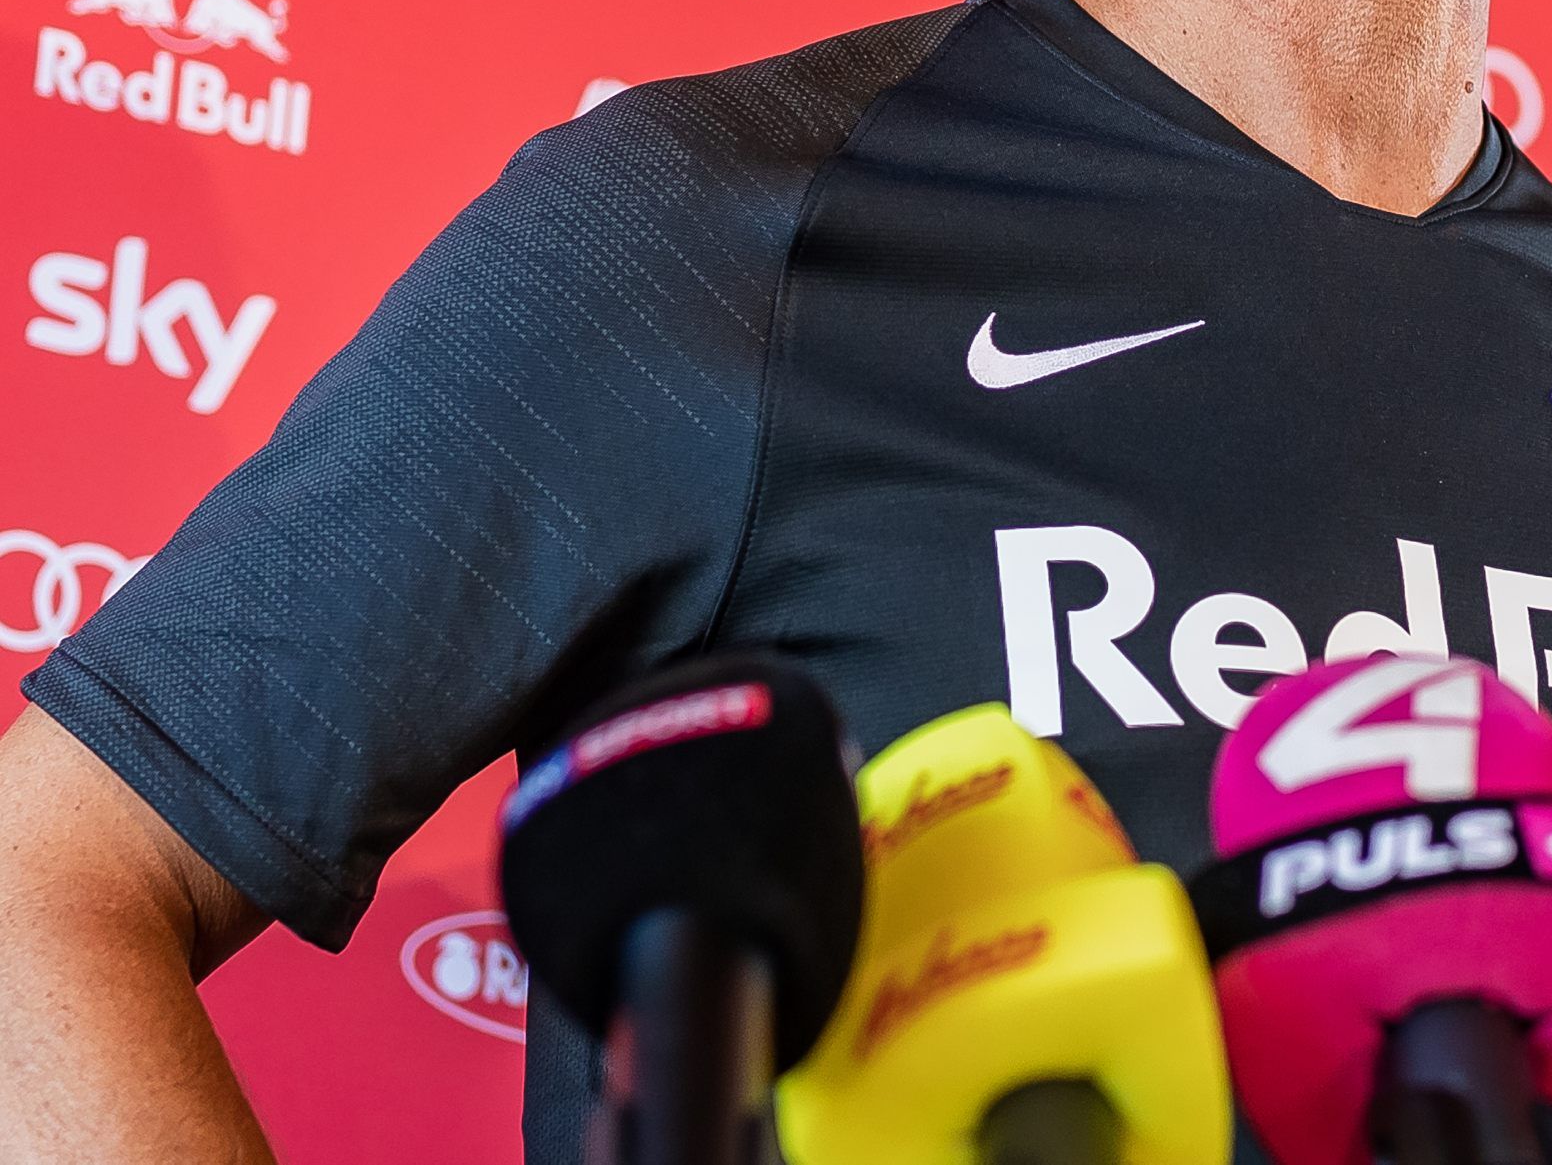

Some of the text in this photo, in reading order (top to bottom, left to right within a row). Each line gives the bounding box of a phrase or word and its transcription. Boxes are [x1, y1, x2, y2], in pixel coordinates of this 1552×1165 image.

[33, 25, 311, 155] Red Bull
[25, 235, 277, 415] sky
[994, 524, 1452, 738] Red
[1257, 654, 1482, 800] 4
[1258, 806, 1519, 918] PULS
